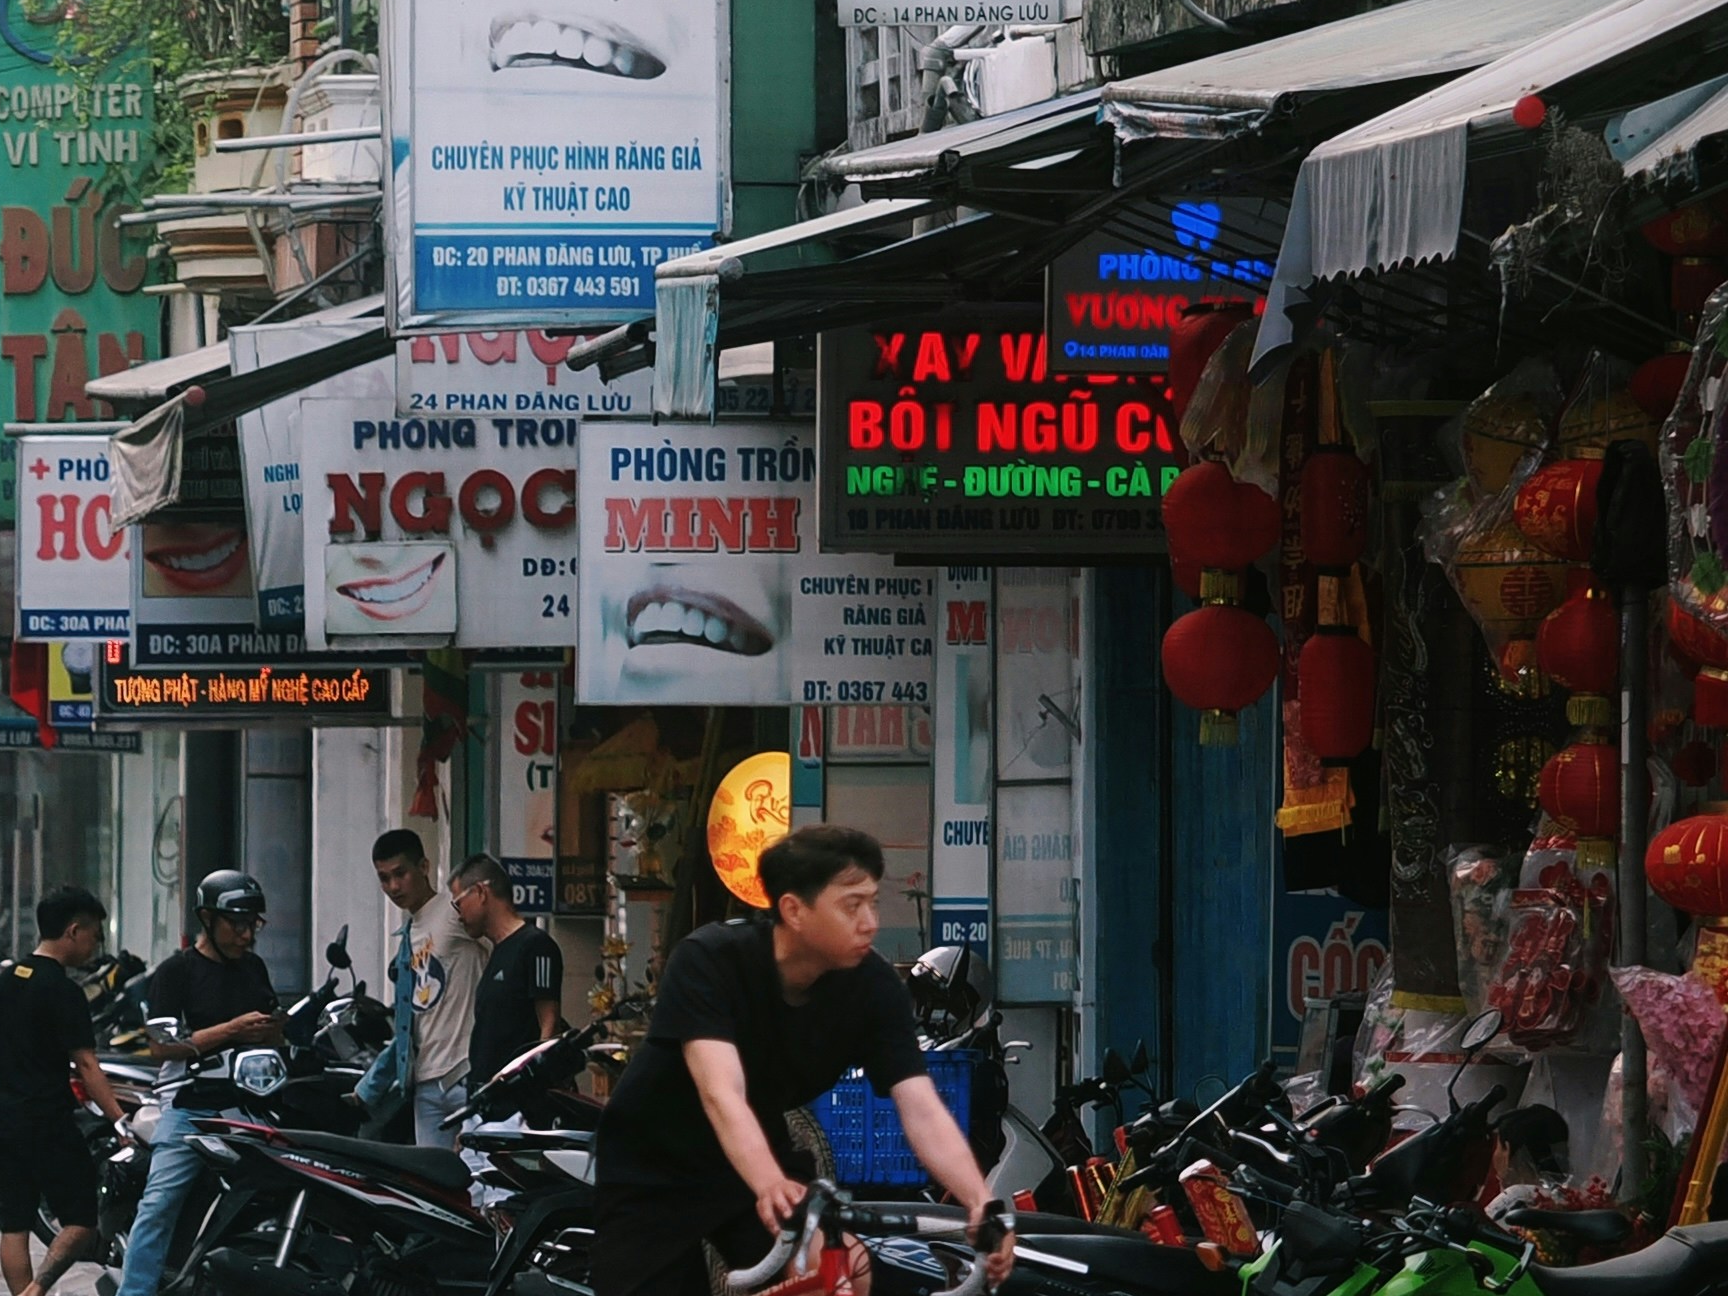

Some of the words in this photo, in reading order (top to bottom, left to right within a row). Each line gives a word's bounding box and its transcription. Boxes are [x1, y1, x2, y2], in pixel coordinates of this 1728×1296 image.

[892, 7, 910, 23] 14
[914, 6, 958, 23] PHAN
[964, 3, 1014, 22] ĐĂNG
[1019, 2, 1049, 21] LƯU
[432, 137, 504, 172] CHUYÊN
[510, 145, 559, 178] PHỤC
[565, 139, 610, 171] HÌNH
[616, 139, 666, 171] RĂNG
[671, 137, 702, 171] GIẢ
[503, 180, 528, 213] KỸ
[532, 182, 590, 219] THUẬT
[594, 186, 631, 213] CAO
[433, 247, 463, 268] ĐC:
[467, 247, 489, 268] 20
[493, 247, 542, 268] PHAN
[545, 242, 594, 268] ĐĂNG
[598, 244, 637, 271] LƯU,
[641, 247, 663, 268] TP
[497, 275, 523, 297] ĐT:
[527, 275, 570, 297] 0367
[573, 275, 607, 297] 443
[610, 275, 641, 297] 591
[1100, 344, 1136, 358] PHAN
[410, 394, 439, 410] 24
[445, 394, 510, 411] PHAN
[514, 390, 580, 412] ĐĂNG
[587, 392, 632, 412] LƯU
[976, 388, 1100, 453] NGŨ
[58, 451, 110, 482] PHÒ
[611, 439, 726, 482] PHÒNG
[737, 435, 816, 482] TRỒN
[963, 458, 1082, 497] ĐƯỜNG
[1105, 460, 1153, 497] CÀ
[326, 467, 576, 554] NGỌC
[876, 509, 932, 530] PHAN
[604, 497, 801, 553] MINH
[800, 573, 870, 596] CHUYÊN
[875, 577, 923, 600] PHỤC
[29, 615, 55, 632] ĐC:
[59, 615, 90, 632] 30A
[844, 604, 892, 625] RĂNG
[897, 602, 926, 625] GIẢ
[149, 634, 181, 654] ĐC:
[186, 634, 223, 654] 30A
[824, 634, 846, 656] KỸ
[852, 634, 905, 660] THUẬT
[910, 637, 932, 656] CA
[804, 681, 831, 702] ĐT:
[838, 680, 884, 702] 0367
[891, 680, 928, 702] 443
[942, 921, 966, 943] ĐC:
[969, 921, 988, 943] 20
